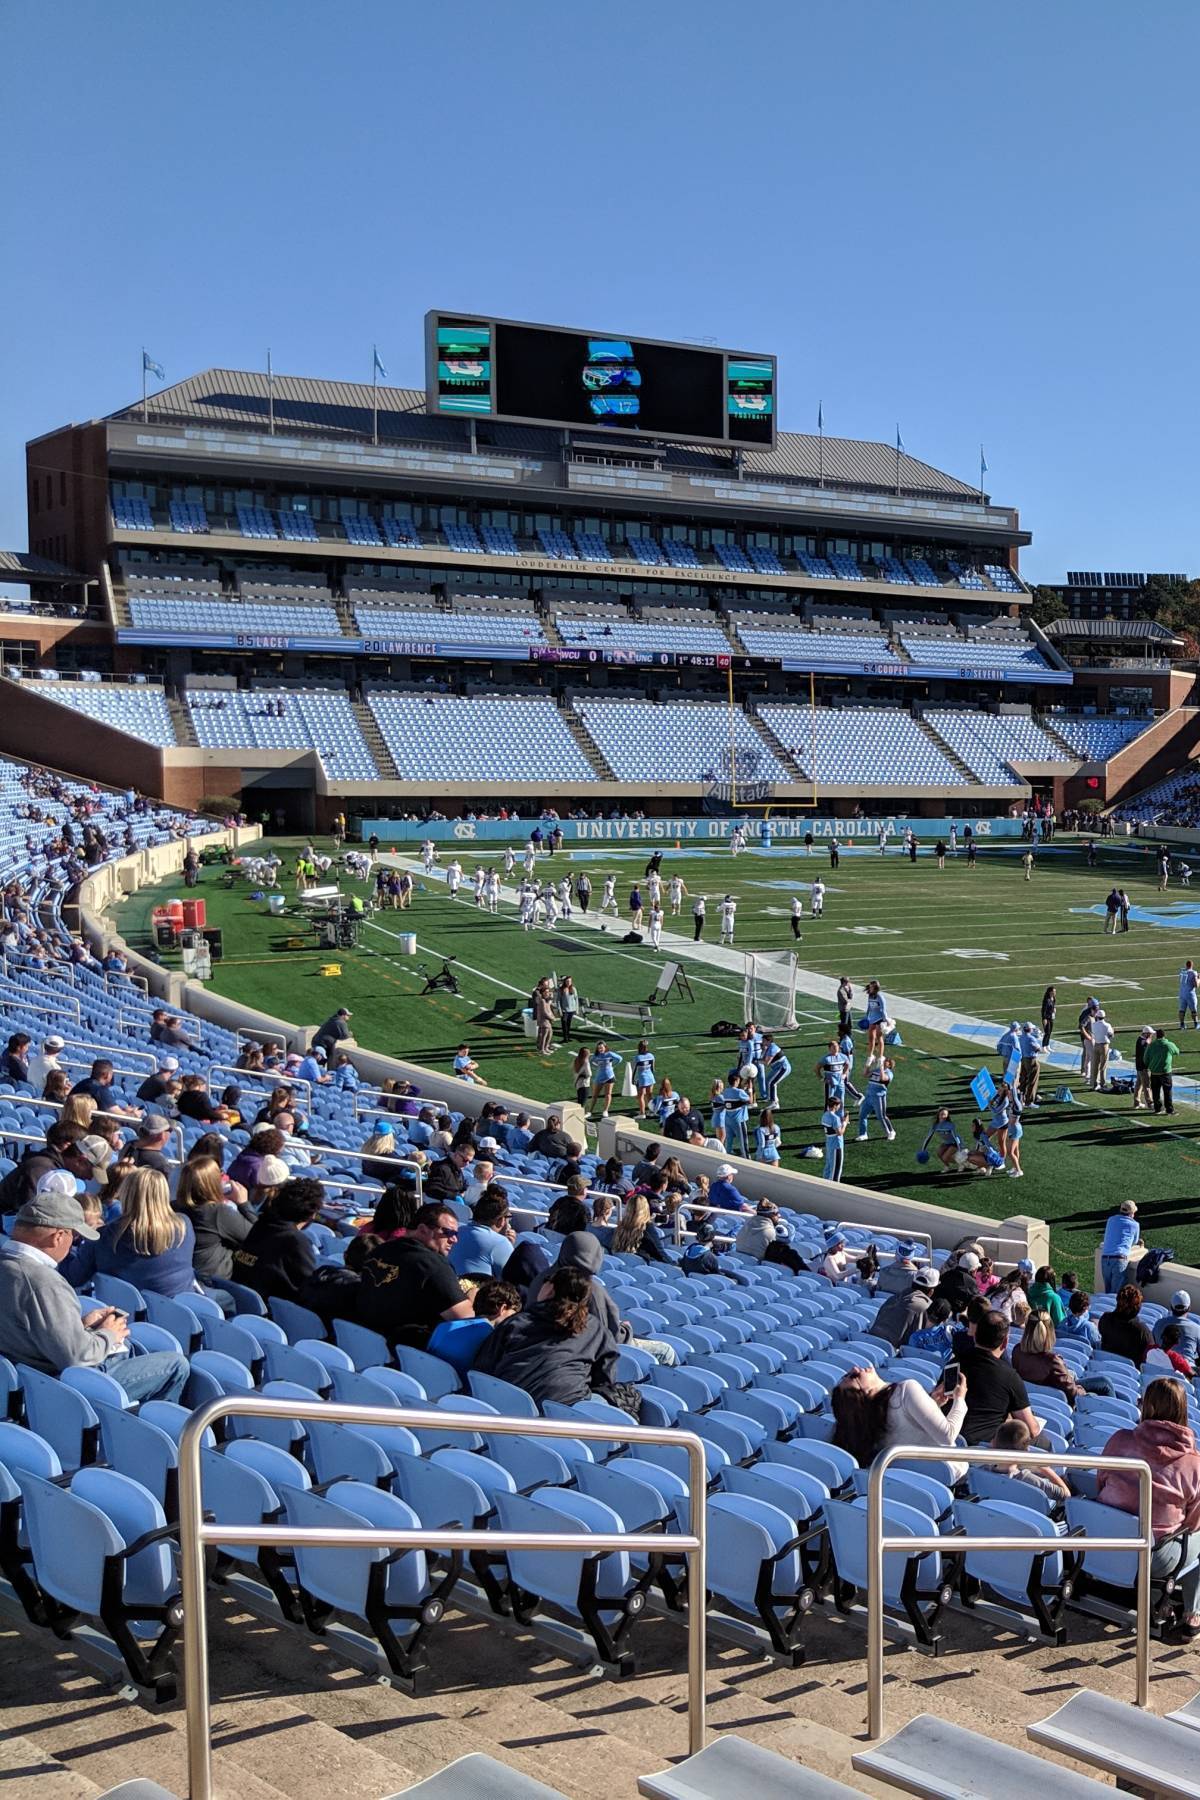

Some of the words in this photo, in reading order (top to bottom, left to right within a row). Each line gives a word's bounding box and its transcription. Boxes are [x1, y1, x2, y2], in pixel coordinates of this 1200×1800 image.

[257, 636, 290, 648] LACEY
[364, 640, 380, 652] 20
[382, 641, 437, 654] LAWRENCE
[561, 650, 580, 660] WCU
[589, 650, 597, 662] 0
[636, 652, 653, 662] UNC
[661, 653, 668, 664] 0
[691, 656, 715, 666] 48:12
[719, 658, 729, 666] 40
[864, 663, 876, 673] 64
[878, 664, 908, 675] COOPER
[974, 669, 1004, 680] SEVERIN
[710, 783, 769, 802] Allstate
[576, 822, 698, 838] UNIVERSITY
[708, 821, 730, 837] OF
[812, 820, 896, 837] CAROLINA
